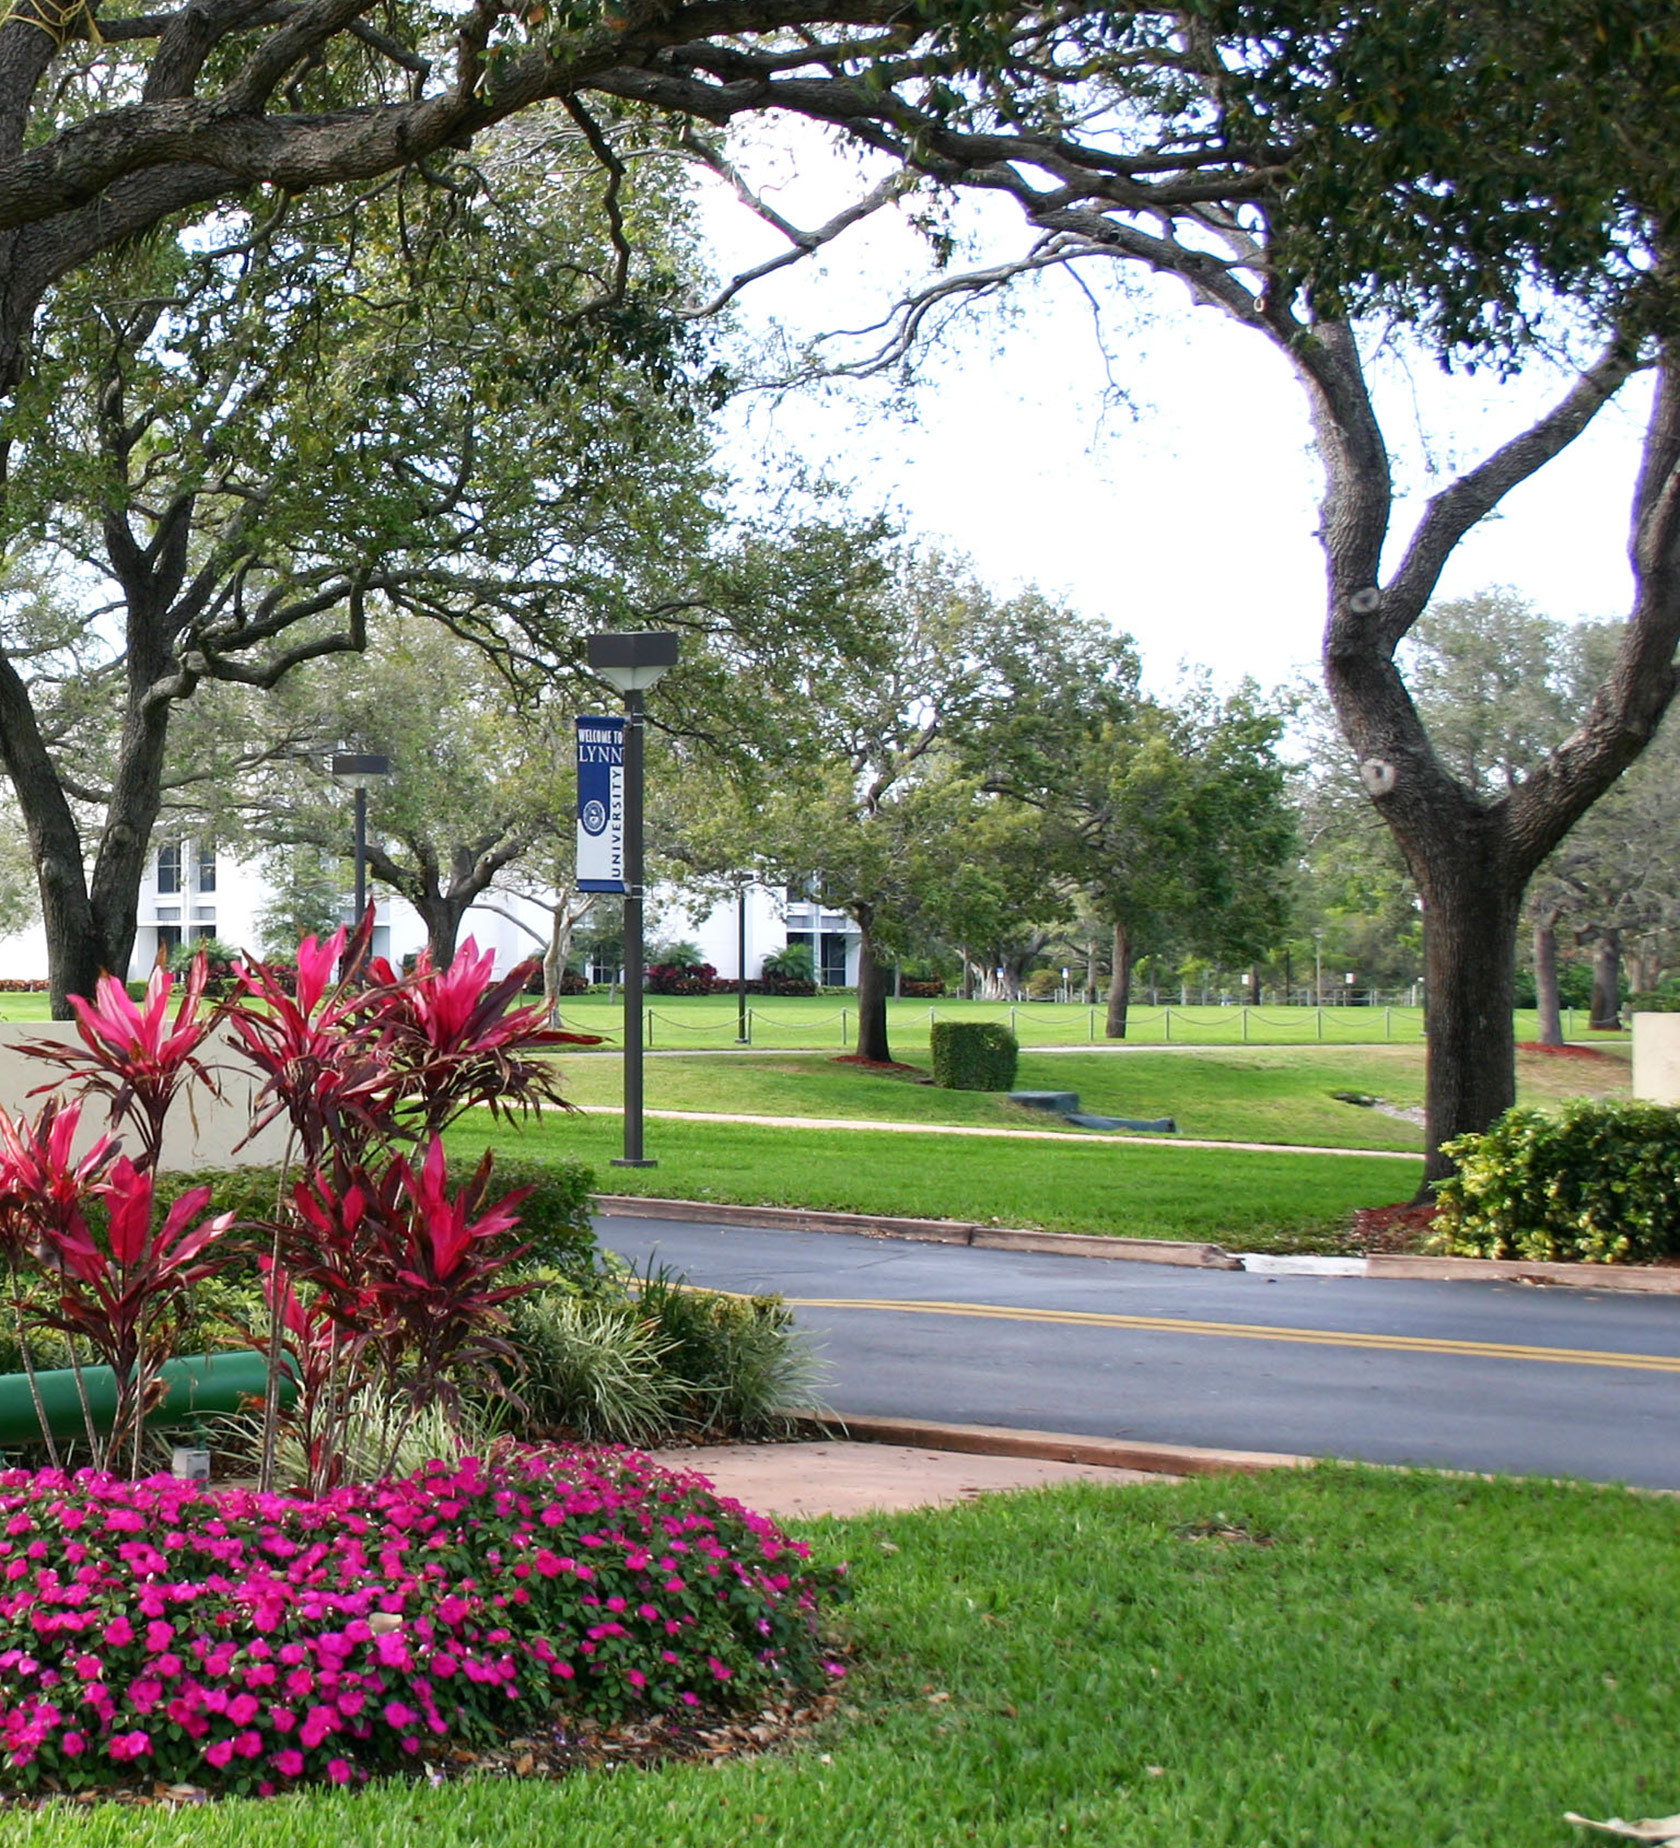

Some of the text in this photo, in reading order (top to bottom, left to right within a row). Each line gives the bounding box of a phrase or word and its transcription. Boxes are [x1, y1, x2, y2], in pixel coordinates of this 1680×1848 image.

[578, 729, 623, 744] WELCOME TO
[579, 745, 624, 763] LYNN
[611, 770, 622, 878] UNIVERSITY
